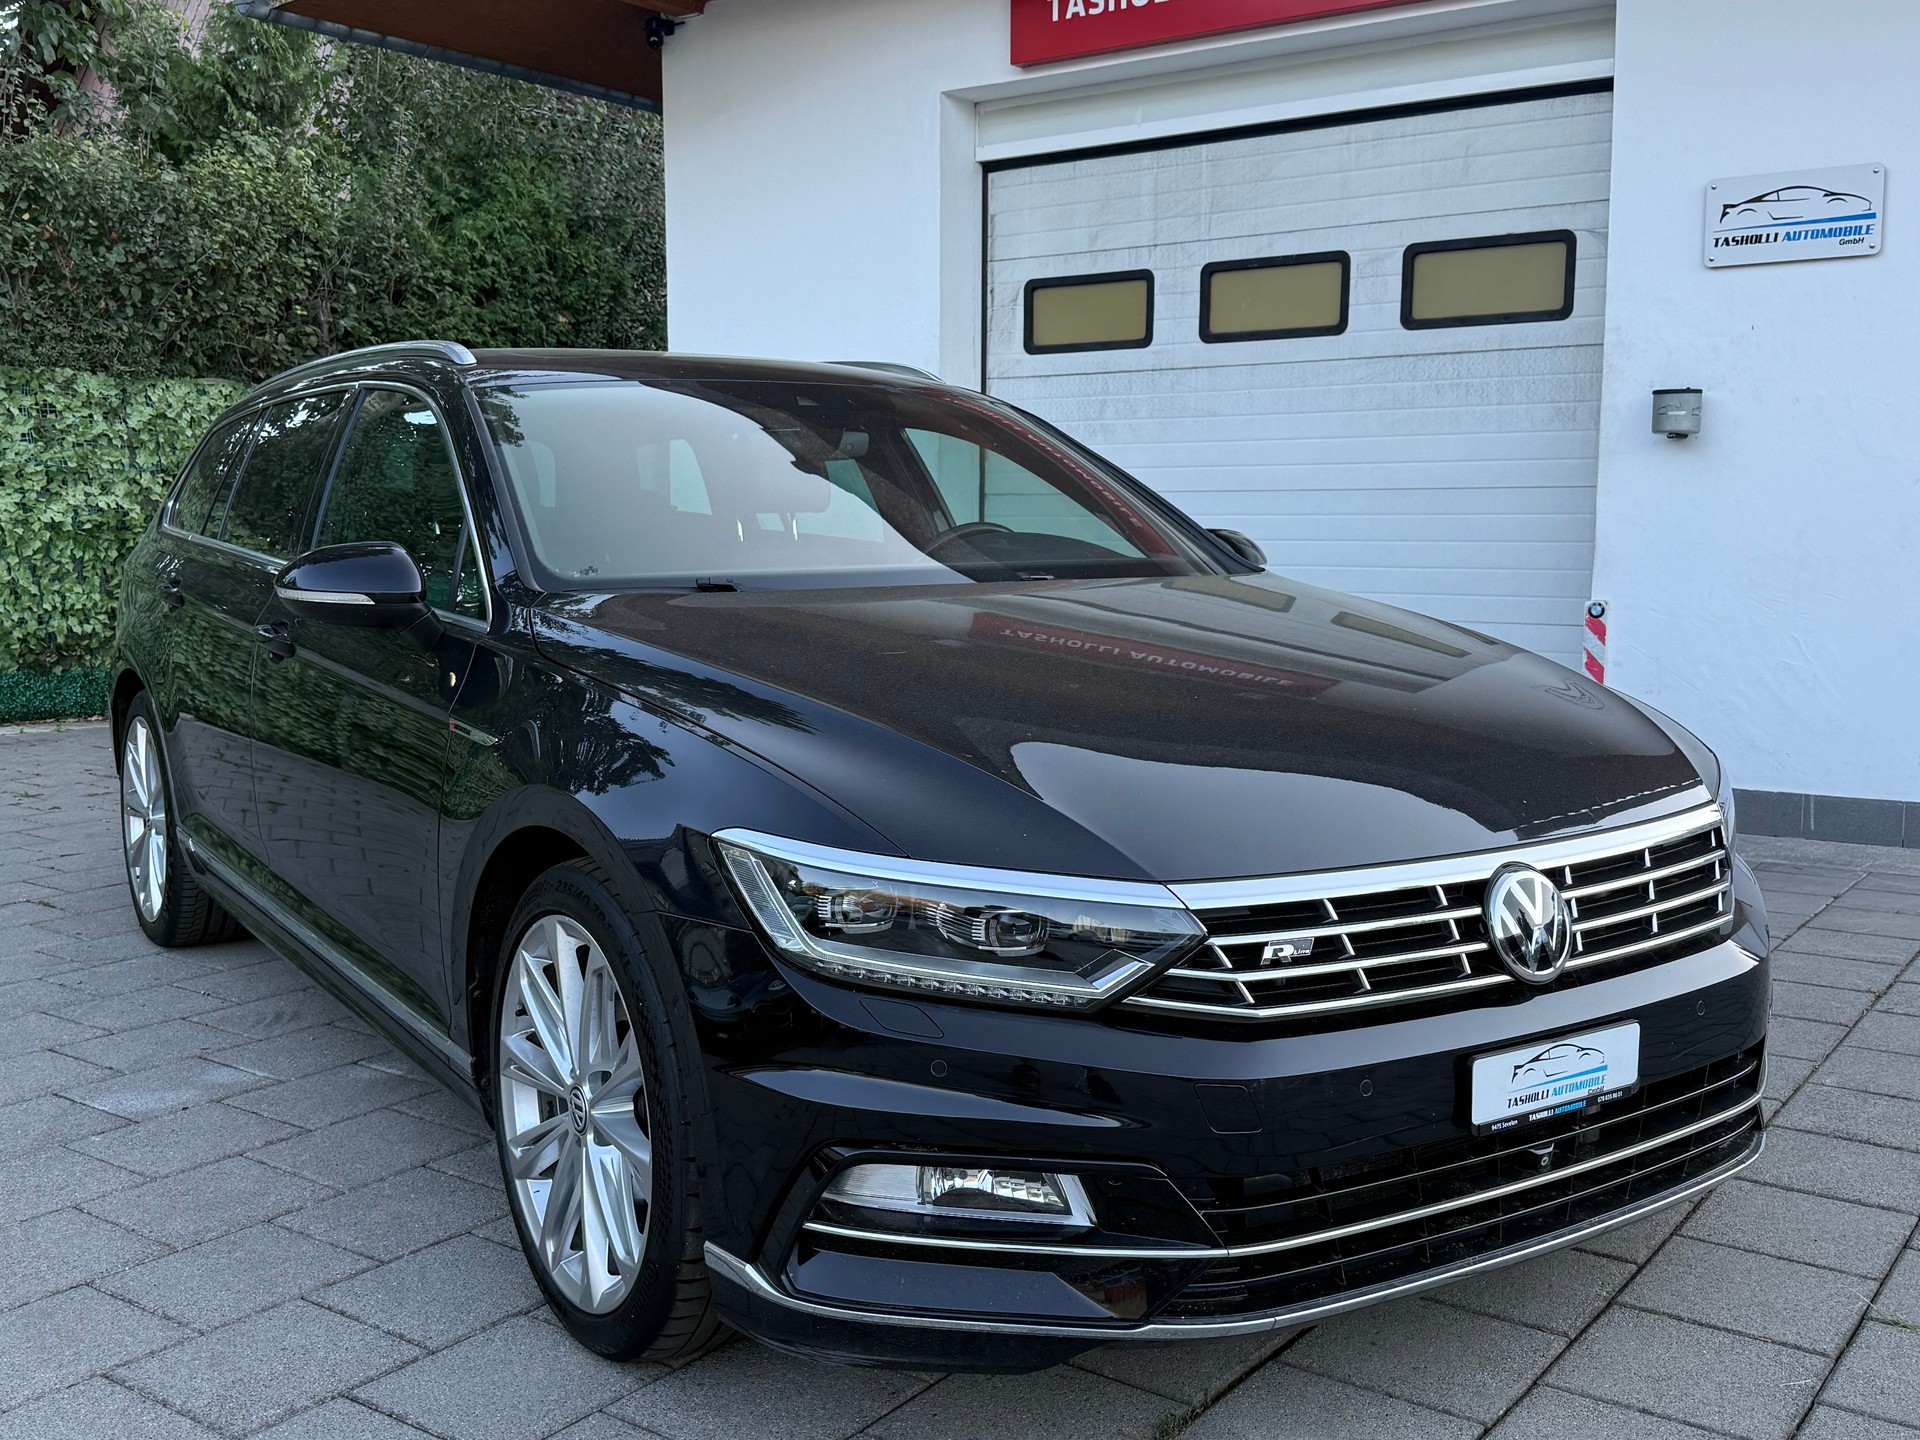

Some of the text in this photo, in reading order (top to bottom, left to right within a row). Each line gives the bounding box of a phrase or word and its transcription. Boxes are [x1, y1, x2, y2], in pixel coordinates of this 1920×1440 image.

[1713, 224, 1875, 248] TASHOLLI AUTOMOBILE
[1838, 237, 1865, 246] GmbH
[1506, 1074, 1607, 1109] TASHOLLI AUTOMOBILE
